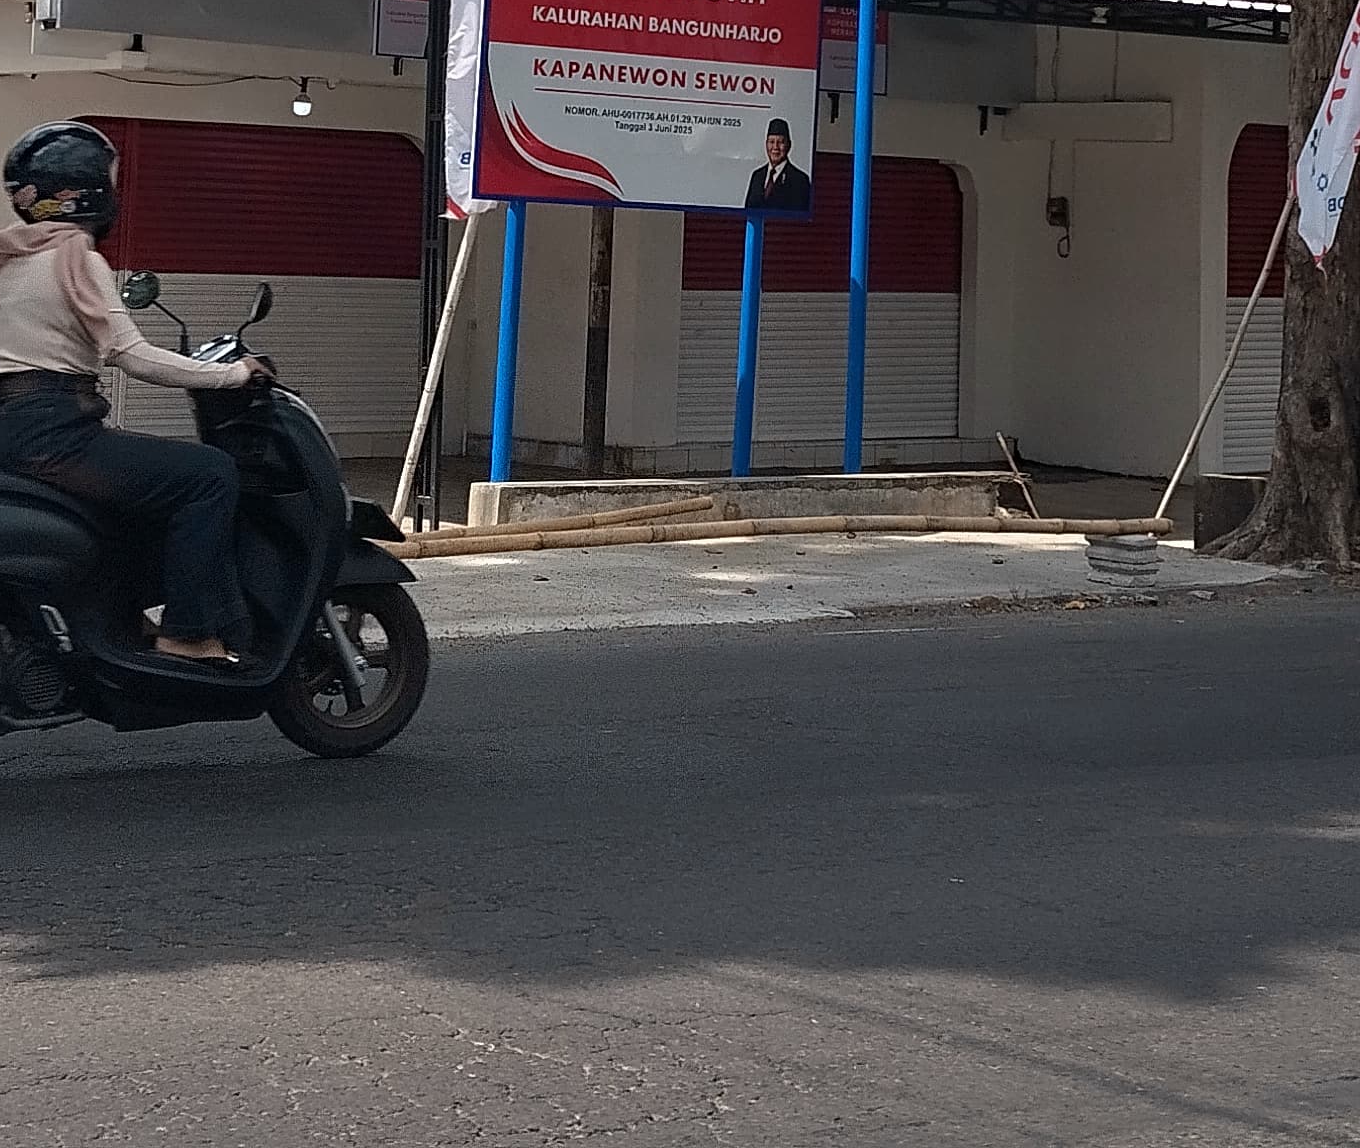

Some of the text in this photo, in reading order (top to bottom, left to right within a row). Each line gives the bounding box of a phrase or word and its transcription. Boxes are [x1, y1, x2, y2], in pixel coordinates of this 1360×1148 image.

[532, 5, 782, 44] KALURAHAN BANGUNHARJO
[533, 58, 776, 95] KAPANEWON SEWON
[615, 120, 646, 133] Tanggal
[655, 124, 672, 133] Juni
[673, 125, 693, 135] 2025
[723, 117, 742, 128] 2025
